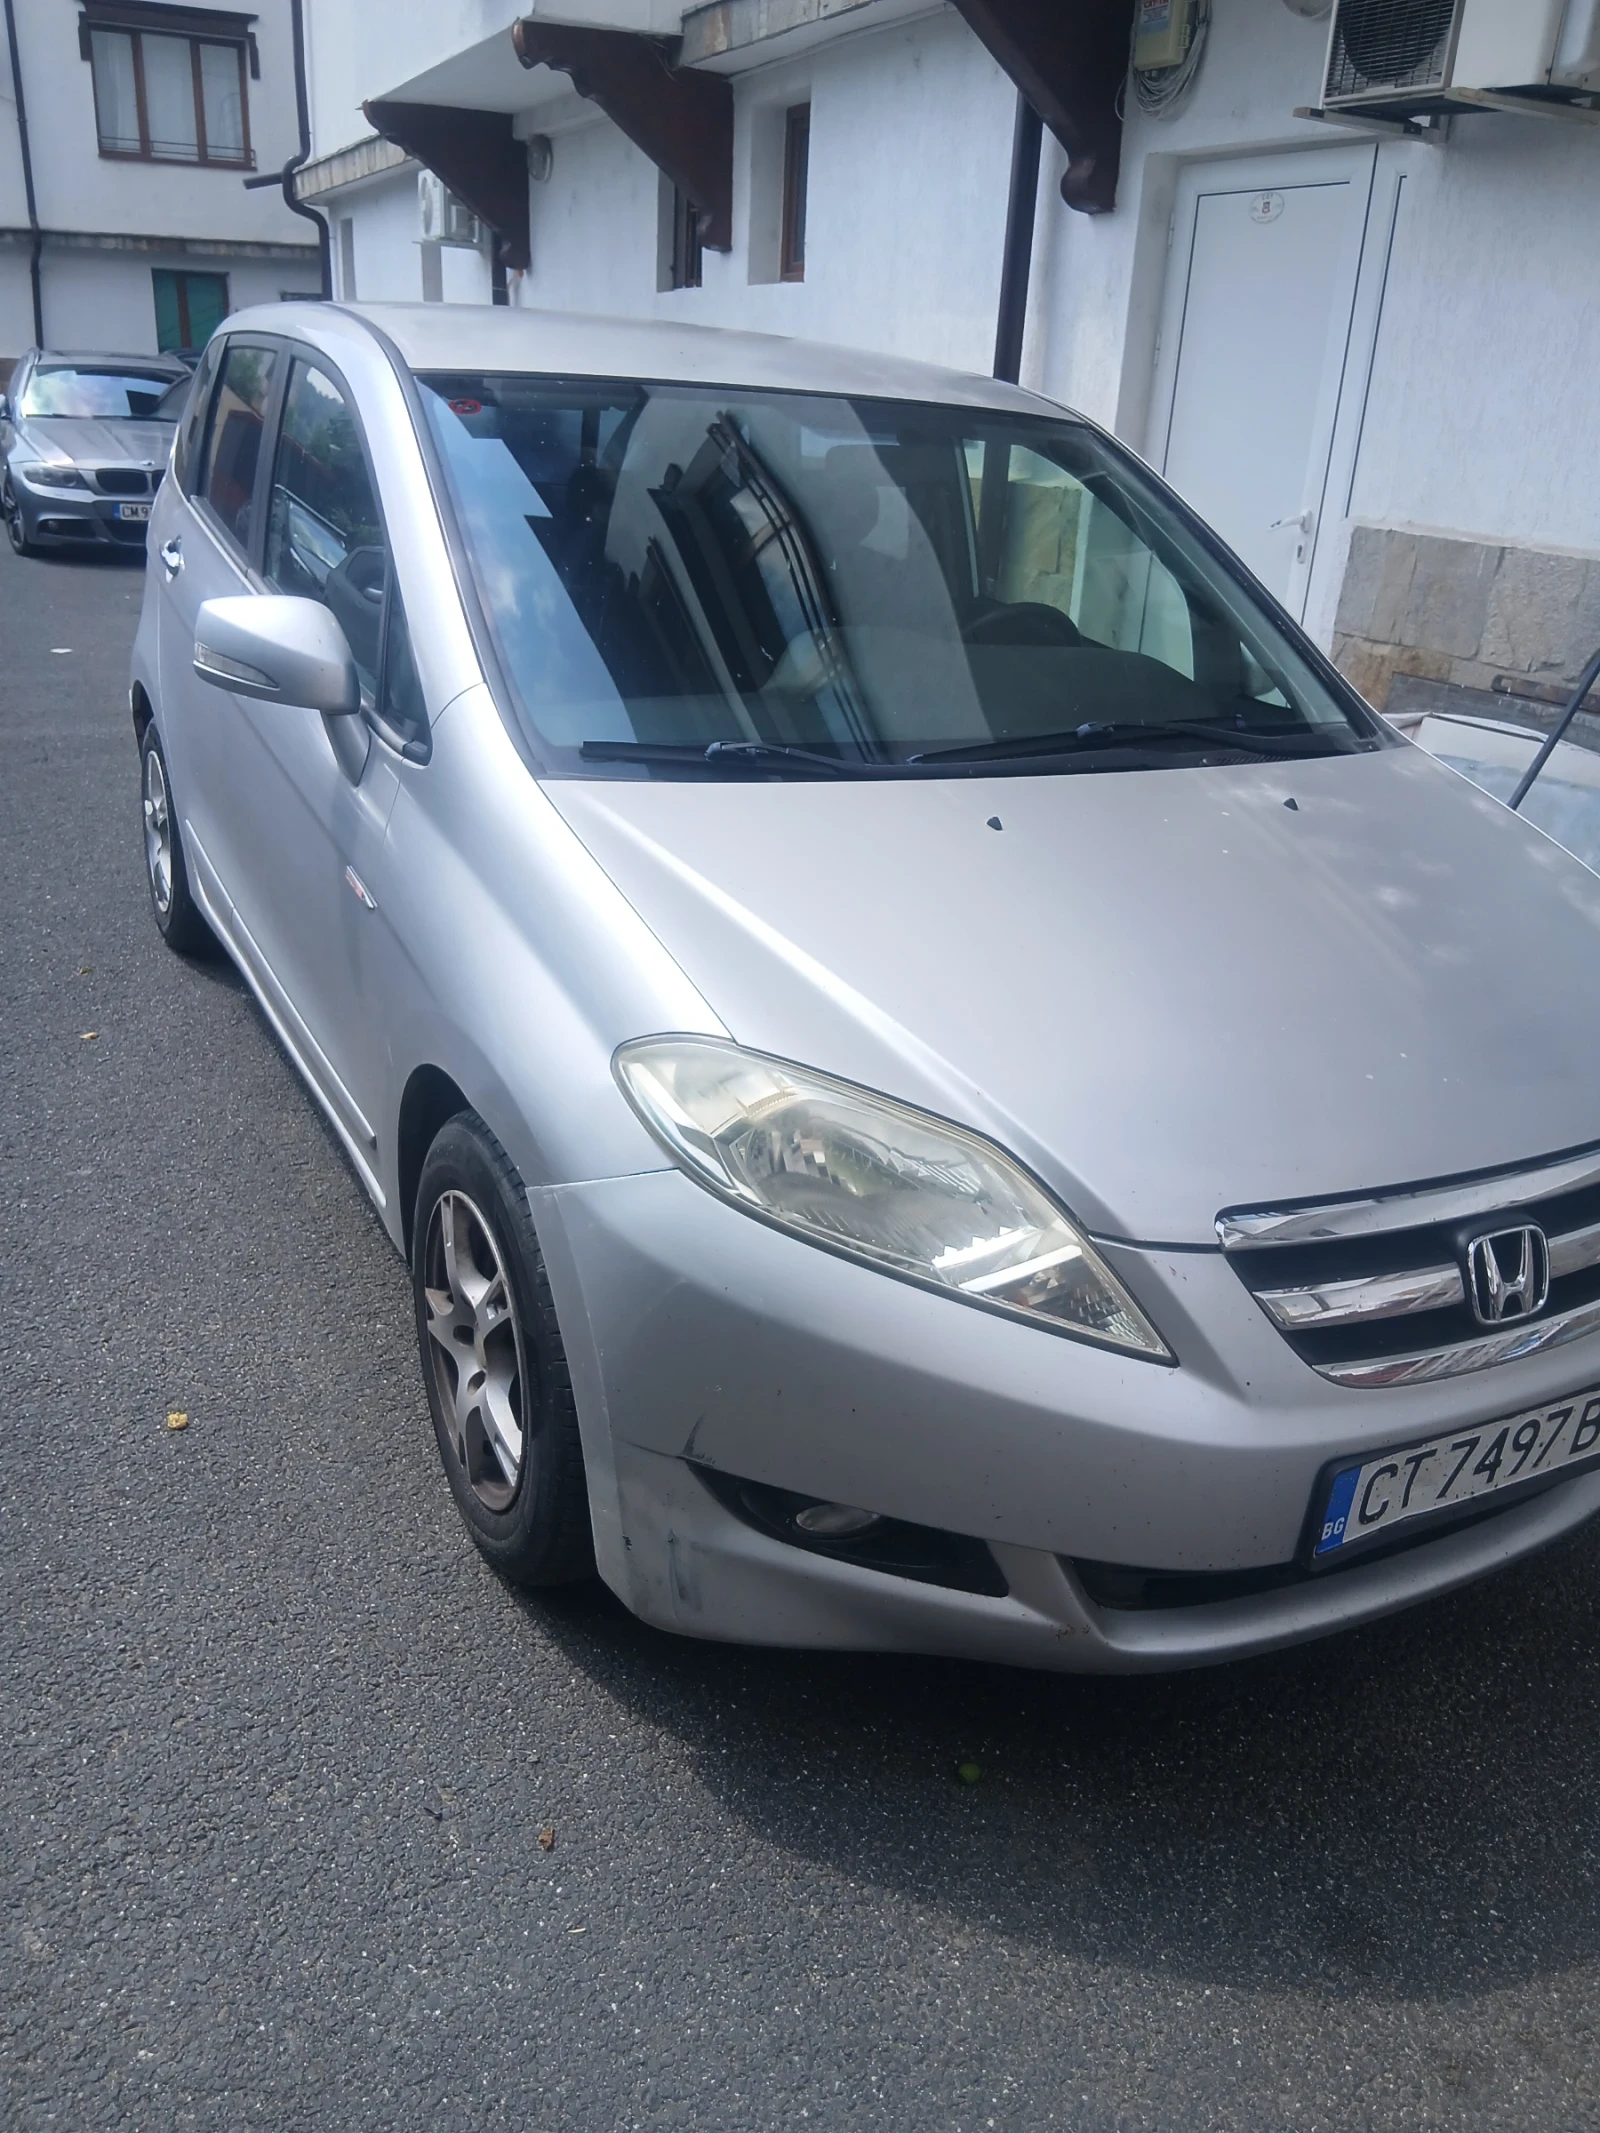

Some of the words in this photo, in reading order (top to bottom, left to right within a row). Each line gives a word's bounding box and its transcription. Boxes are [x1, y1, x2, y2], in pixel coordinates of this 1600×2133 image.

[1358, 1448, 1438, 1525] CT
[1435, 1405, 1574, 1499] 7497
[1321, 1517, 1345, 1541] BG
